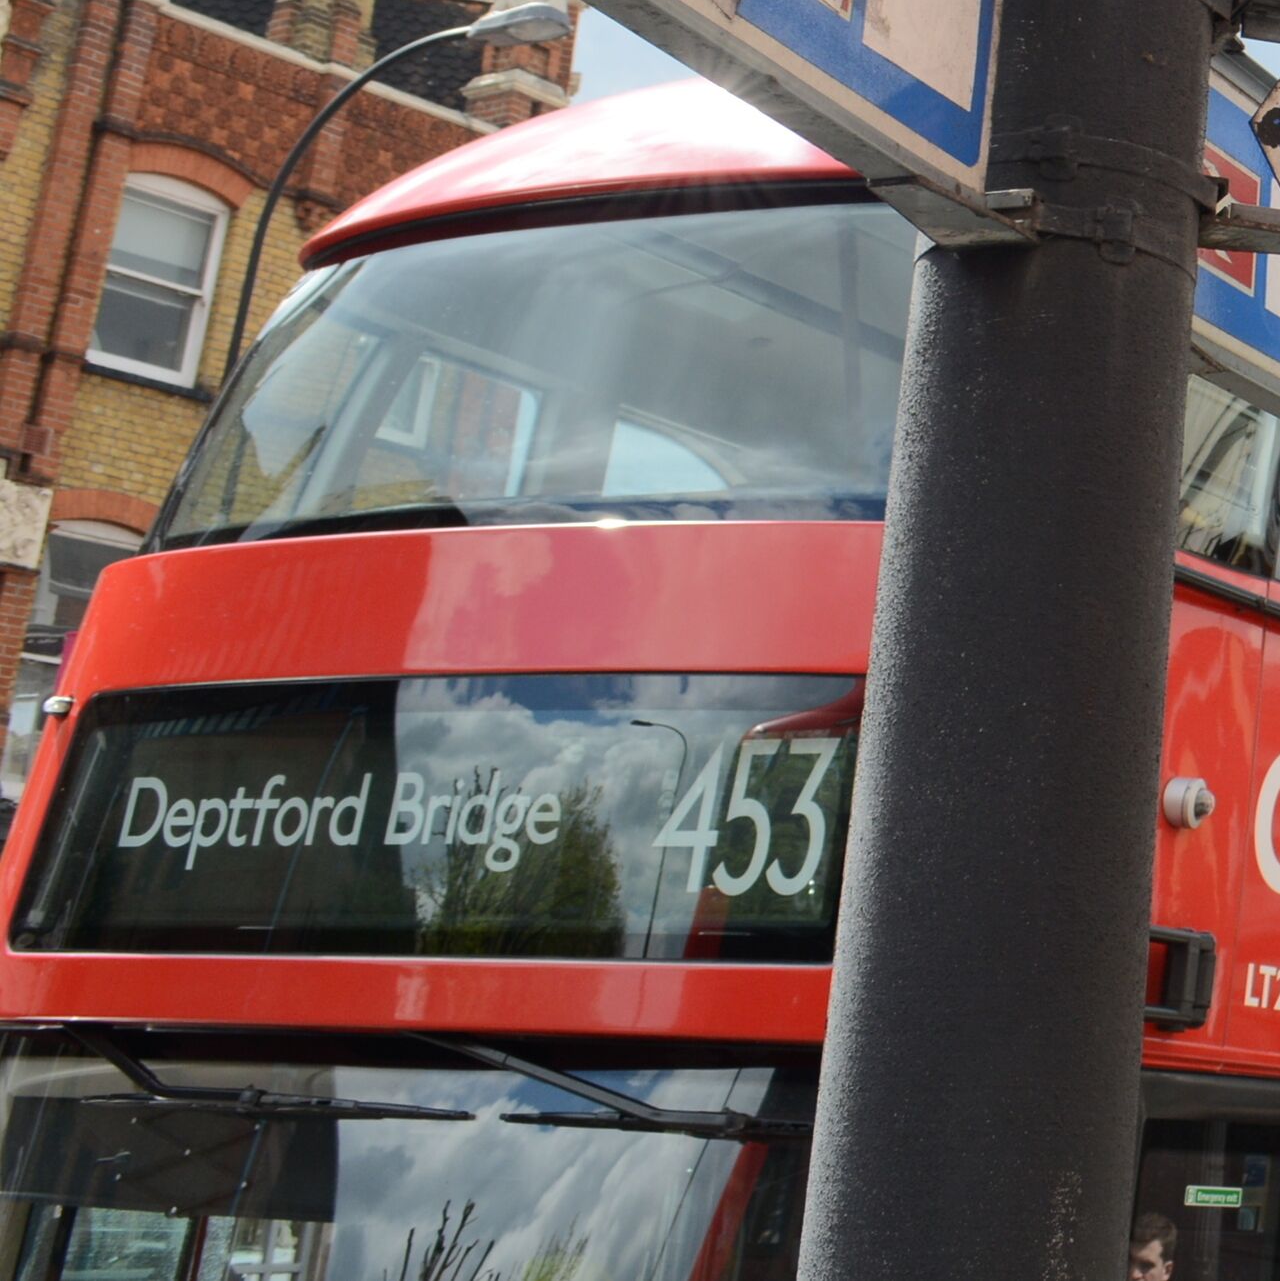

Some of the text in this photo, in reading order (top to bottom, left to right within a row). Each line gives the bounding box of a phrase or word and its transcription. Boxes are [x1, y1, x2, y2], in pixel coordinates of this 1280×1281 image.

[117, 736, 843, 898] Deptford Bridge 453
